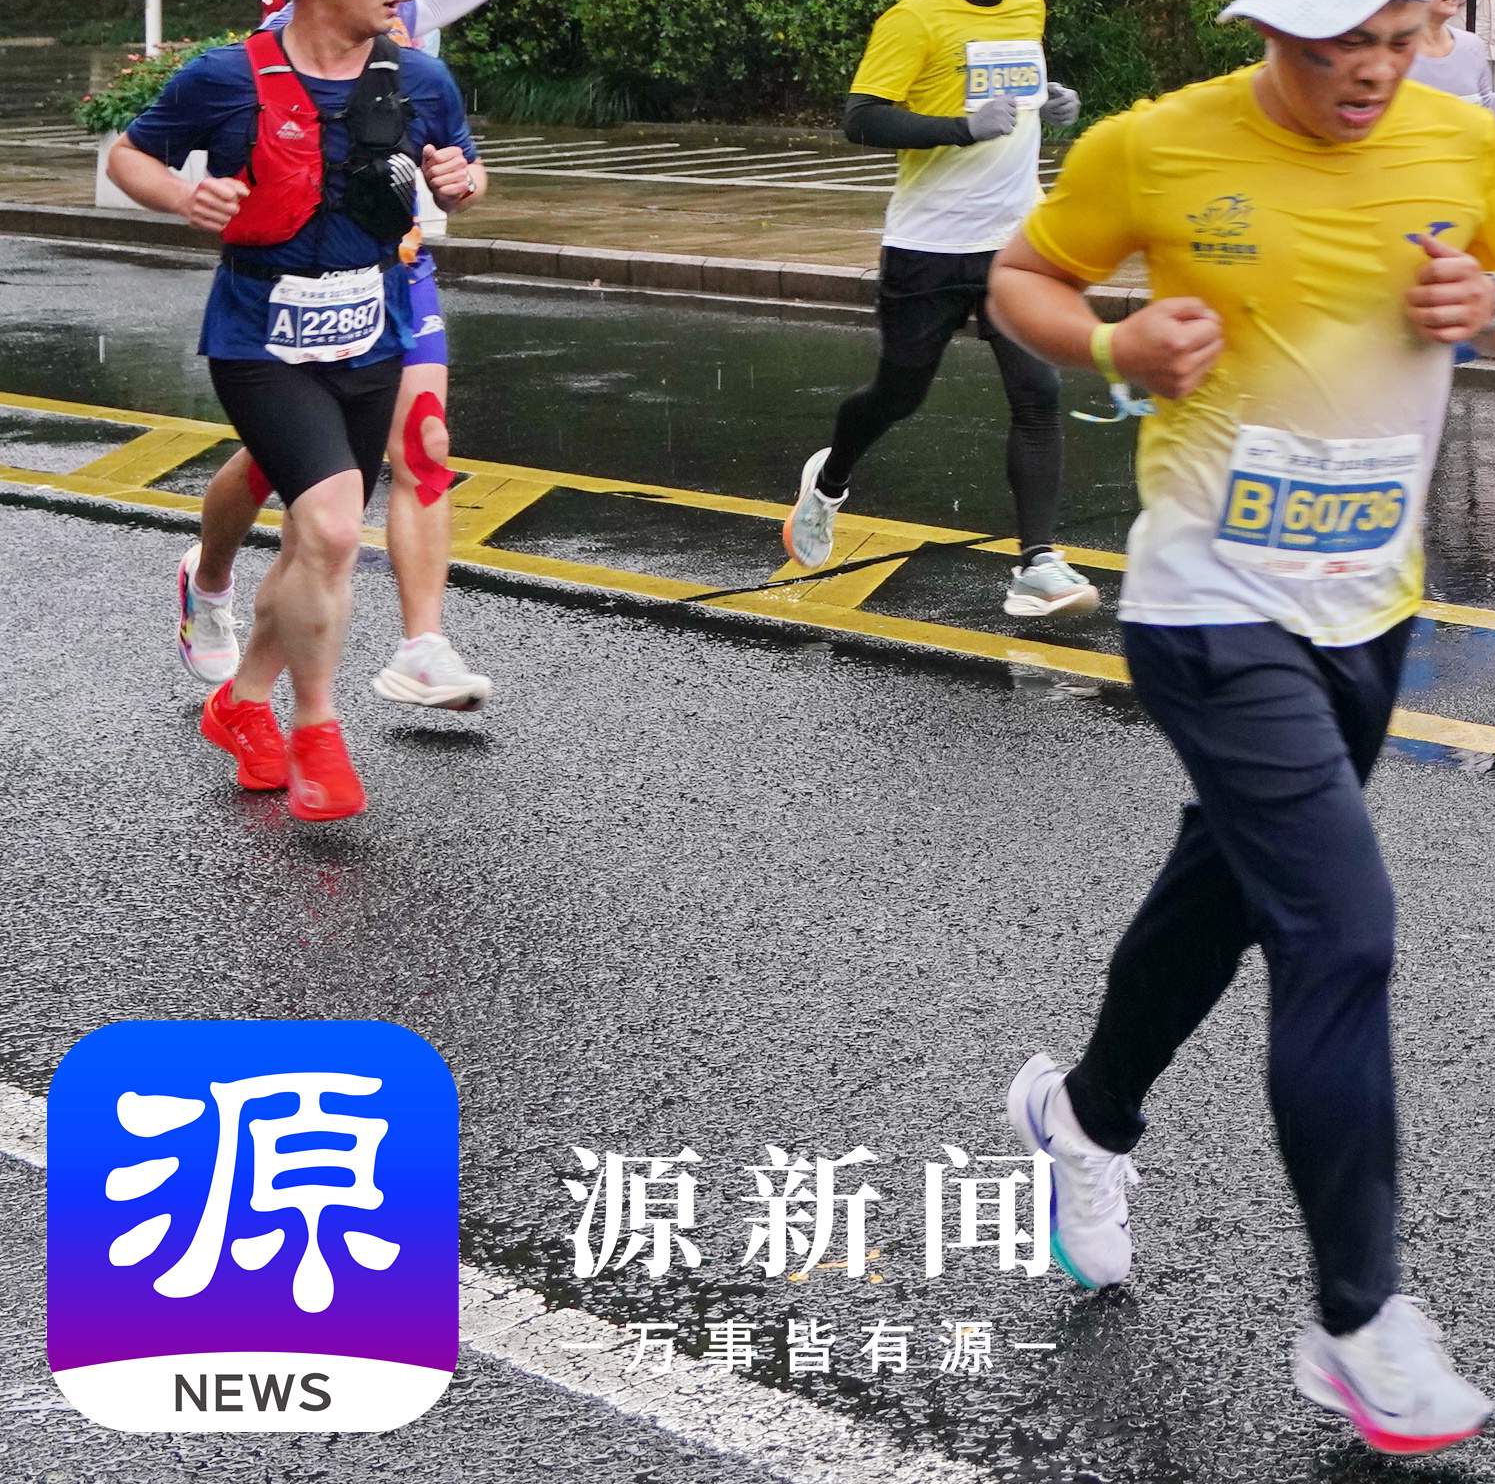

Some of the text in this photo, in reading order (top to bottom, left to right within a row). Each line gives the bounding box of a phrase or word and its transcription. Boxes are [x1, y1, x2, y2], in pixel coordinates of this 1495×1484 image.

[969, 68, 988, 92] B
[271, 308, 295, 339] A
[302, 299, 378, 336] 22887
[1227, 479, 1403, 533] B 60736
